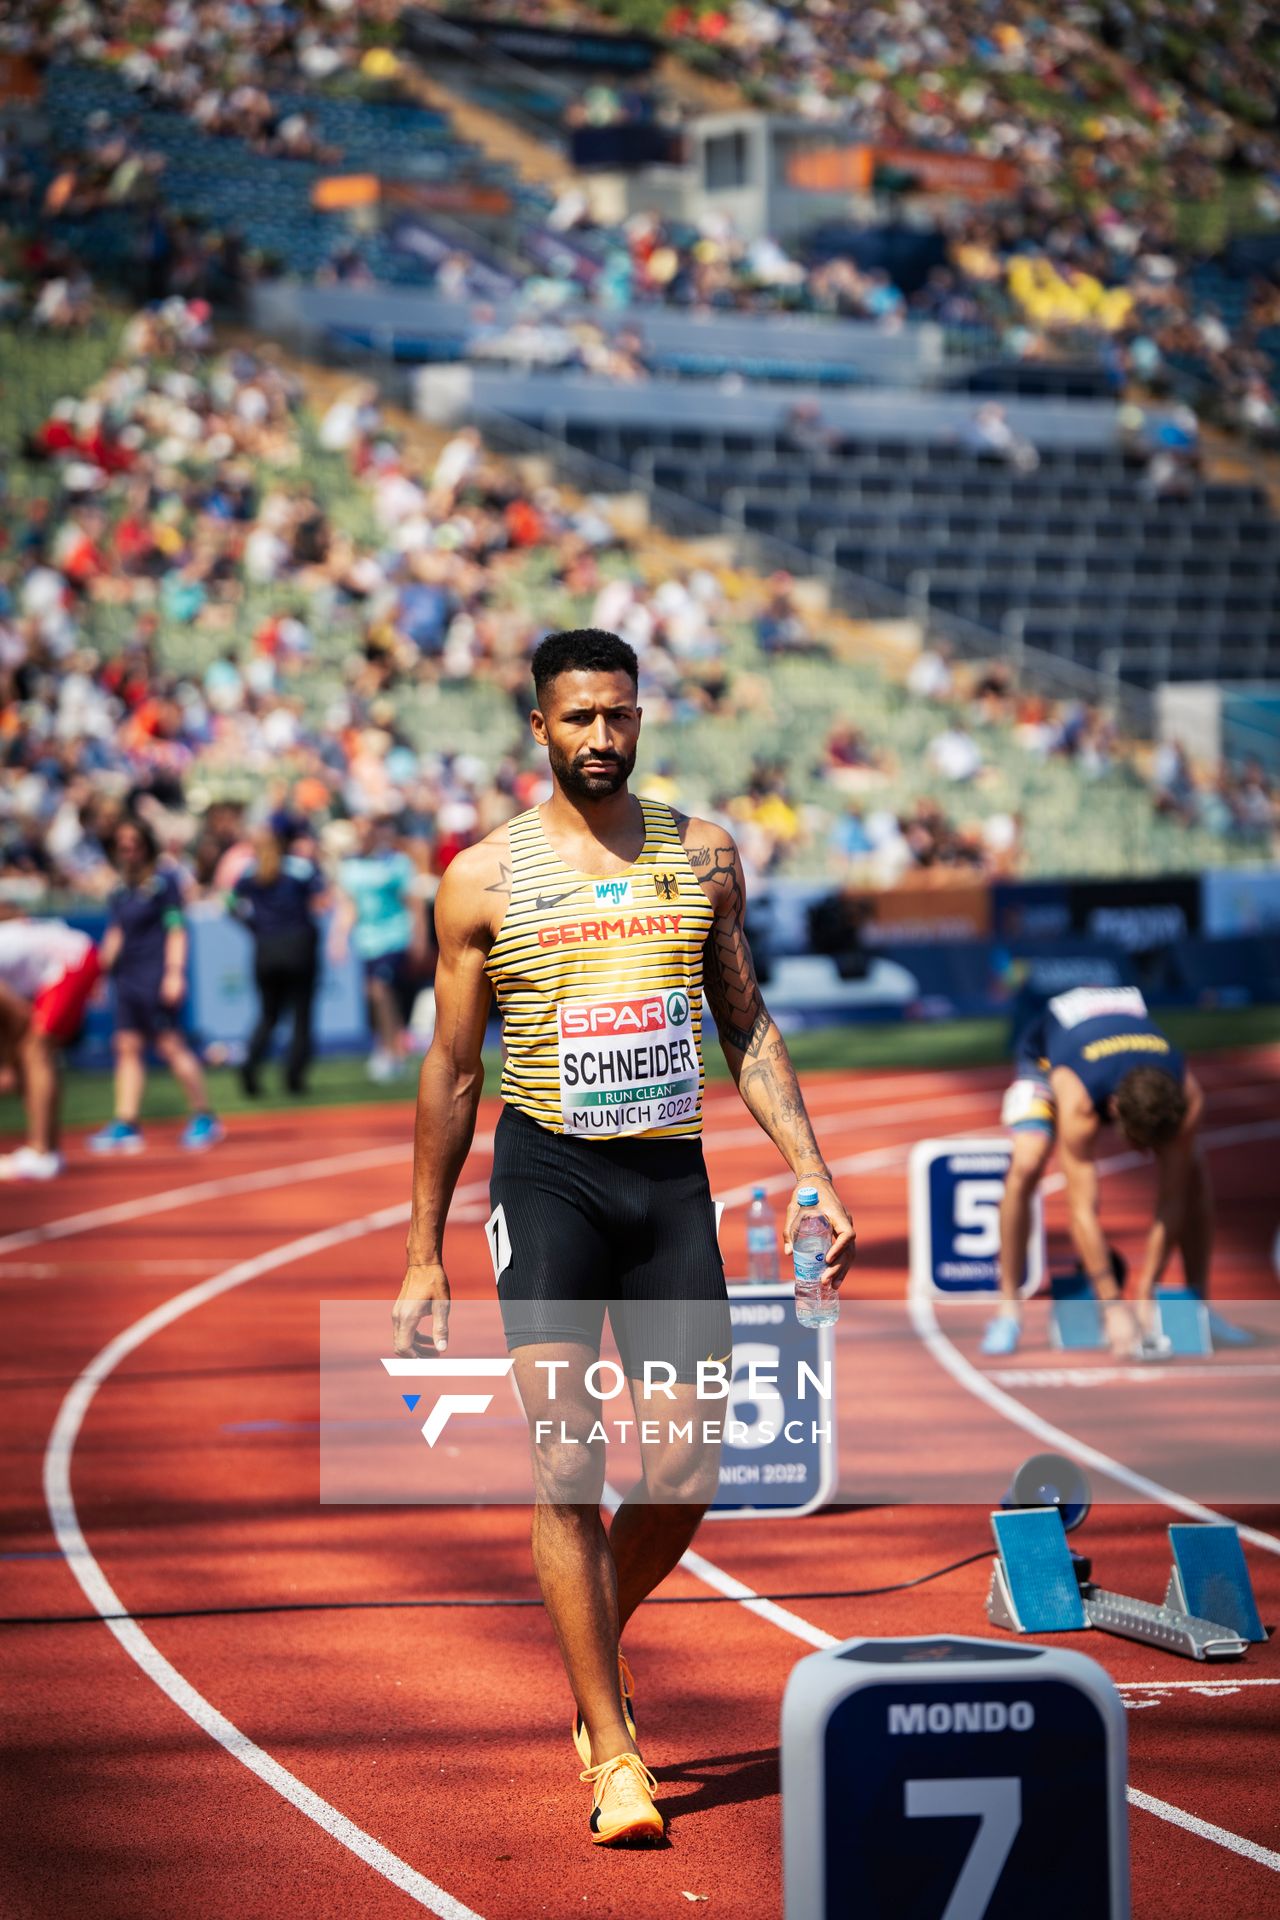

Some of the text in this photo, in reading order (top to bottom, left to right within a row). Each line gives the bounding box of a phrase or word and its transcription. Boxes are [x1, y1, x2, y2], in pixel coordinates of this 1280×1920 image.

[537, 914, 683, 948] GERMANY
[563, 1001, 664, 1033] SPAR
[563, 1038, 695, 1086] SCHNEIDER
[572, 1096, 692, 1129] MUNICH 2022
[605, 1090, 633, 1104] RUN
[951, 1179, 1006, 1258] 5
[728, 1304, 786, 1325] ONDO
[722, 1342, 786, 1450] 6
[718, 1464, 760, 1485] NICH
[887, 1700, 1036, 1735] MONDO
[904, 1776, 1023, 1920] 7
